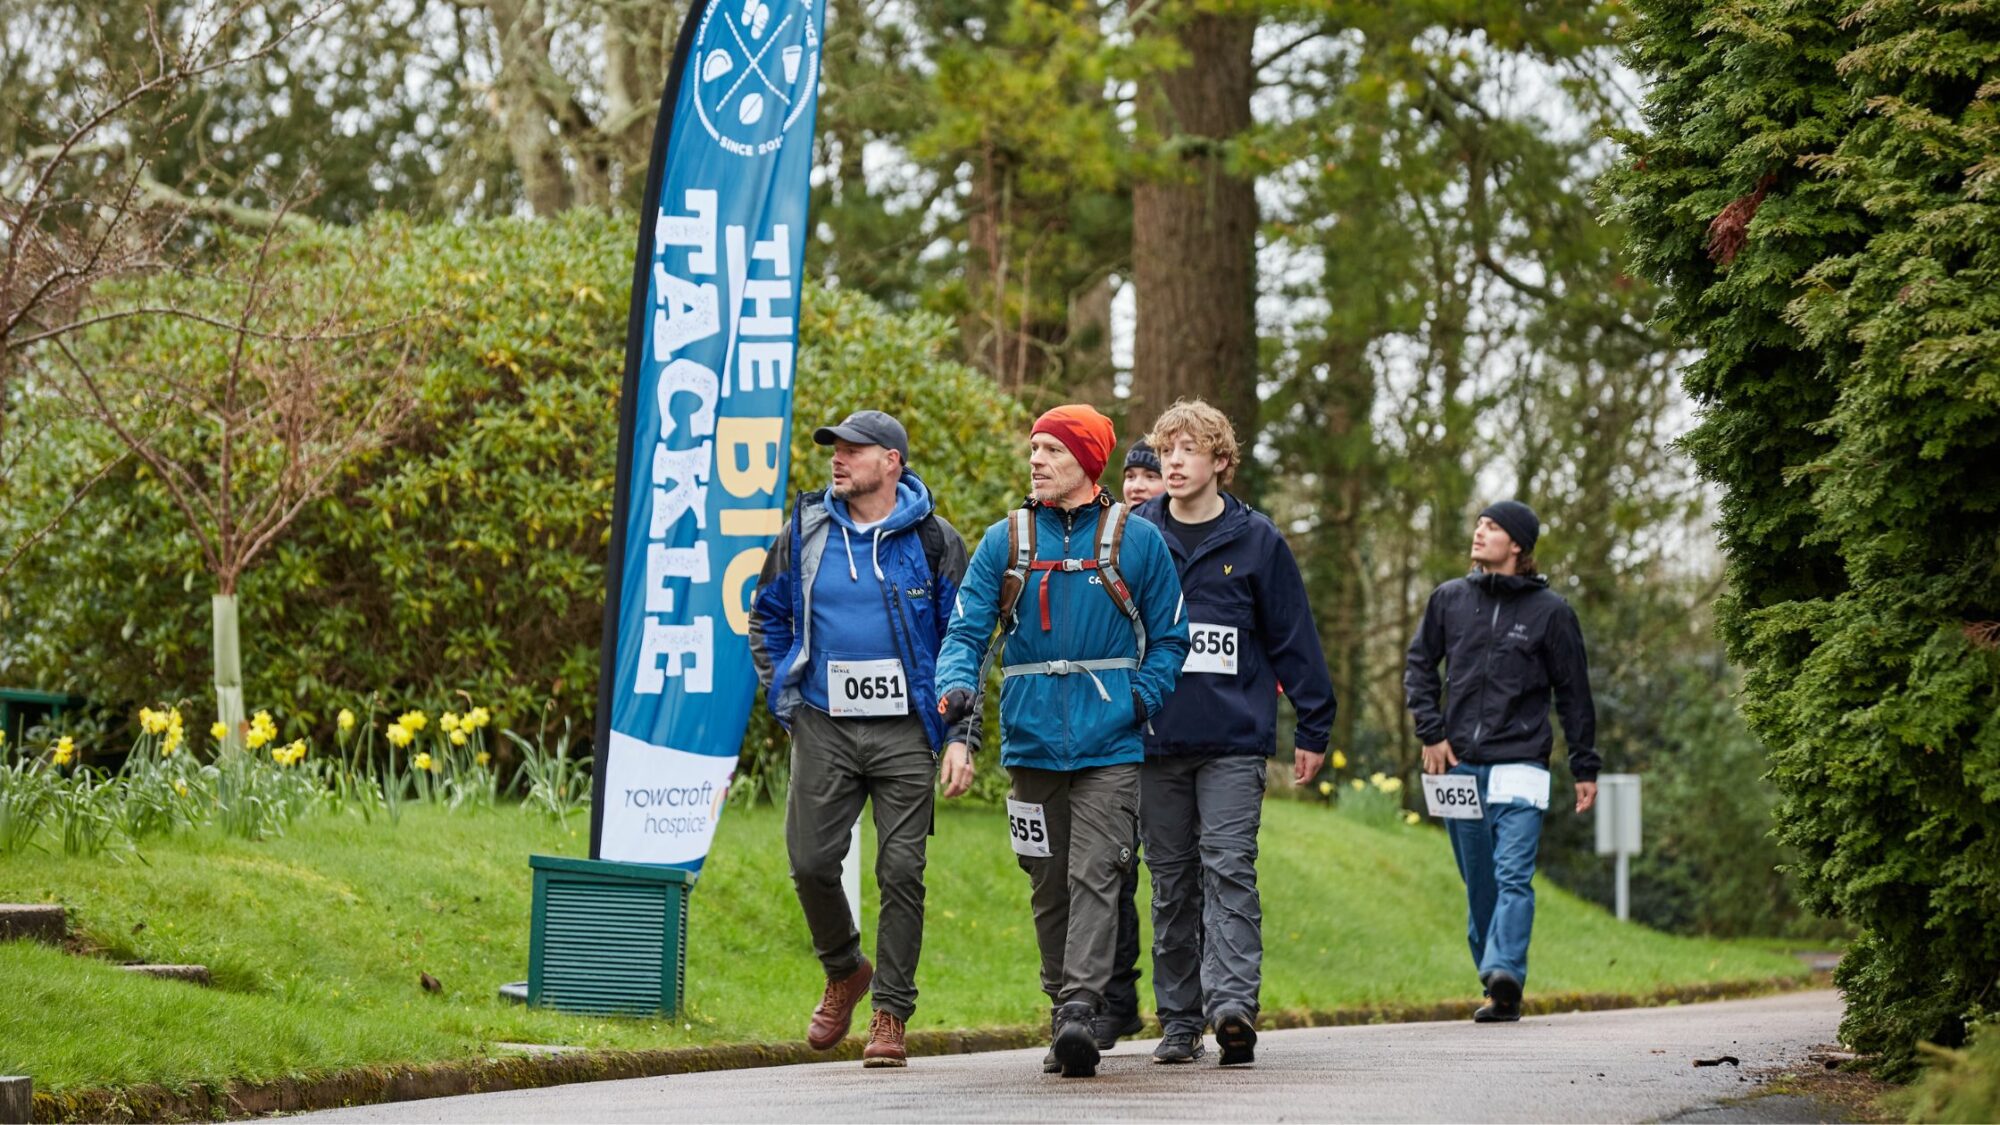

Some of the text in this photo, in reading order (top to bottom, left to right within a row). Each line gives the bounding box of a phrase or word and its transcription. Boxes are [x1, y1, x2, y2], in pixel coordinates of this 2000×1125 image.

[719, 136, 754, 157] SINCE
[633, 189, 721, 694] TACKLE
[715, 224, 794, 636] THE BIG
[1191, 630, 1236, 656] 656
[844, 675, 905, 700] 0651
[624, 780, 712, 808] rowcroft
[1435, 787, 1478, 806] 0652
[644, 811, 707, 838] hospice
